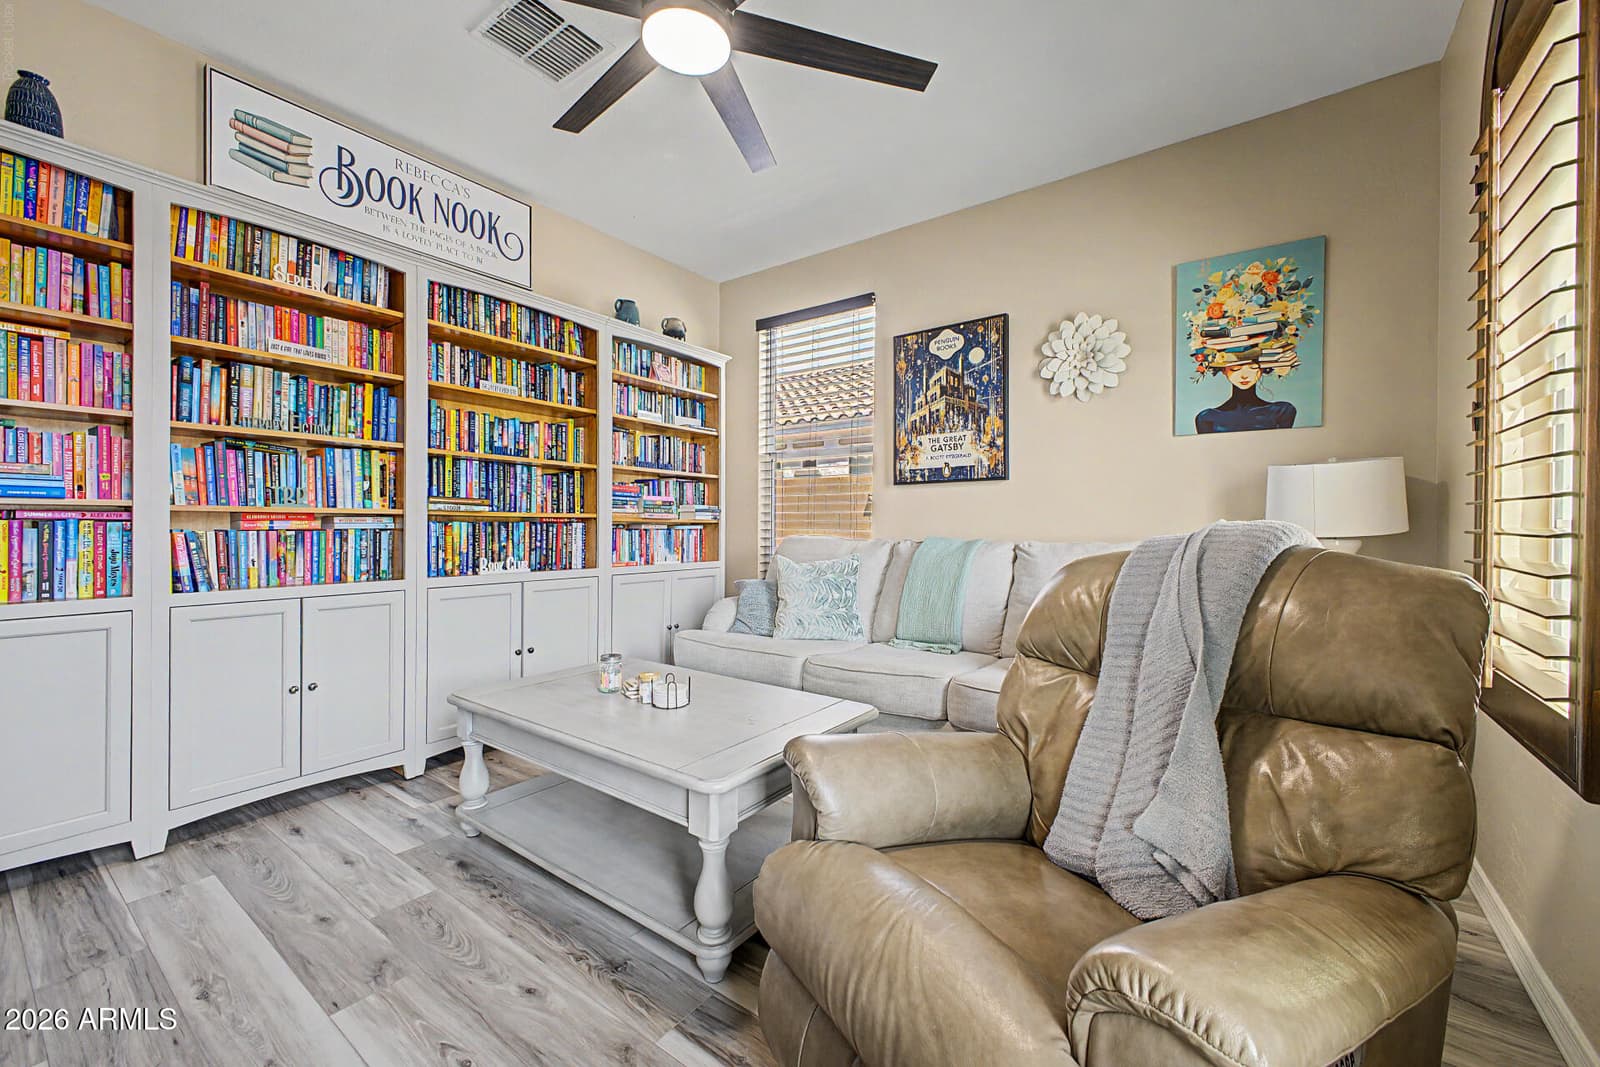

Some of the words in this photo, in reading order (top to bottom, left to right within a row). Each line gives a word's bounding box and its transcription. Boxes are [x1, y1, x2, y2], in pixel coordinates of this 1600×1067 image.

[395, 157, 471, 199] REBECCA'S
[319, 145, 425, 224] BOOK
[433, 192, 524, 261] NOOK
[364, 206, 407, 227] BETWEEN
[934, 335, 960, 346] PENGUIN
[936, 342, 957, 352] BOOKS
[928, 436, 941, 445] THE
[942, 434, 968, 443] GREAT
[930, 442, 964, 453] GATSBY
[108, 565, 121, 587] Moyes
